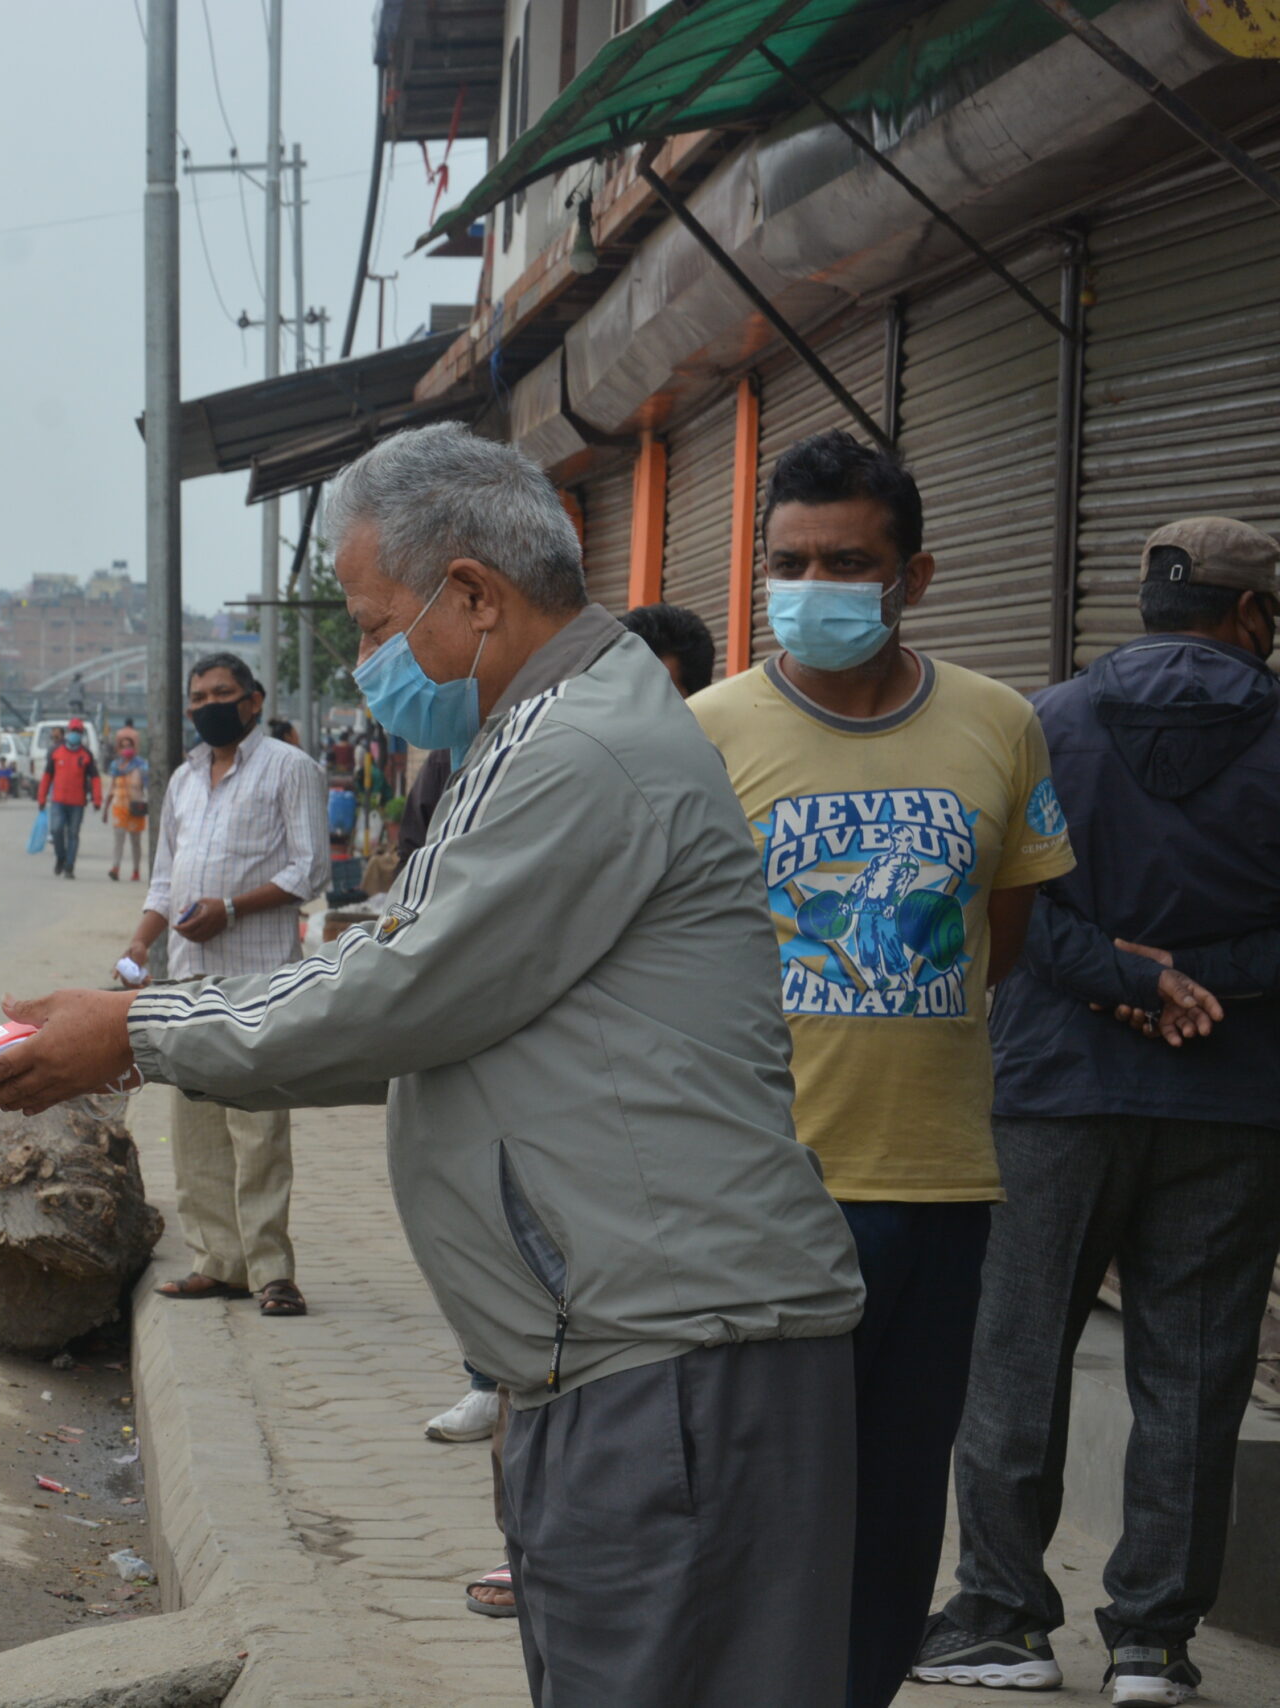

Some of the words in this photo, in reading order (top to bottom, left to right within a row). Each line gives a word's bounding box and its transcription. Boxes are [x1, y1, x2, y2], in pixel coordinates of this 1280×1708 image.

[772, 790, 969, 848] NEVER
[767, 823, 891, 886] GIVE
[918, 826, 972, 874] UP
